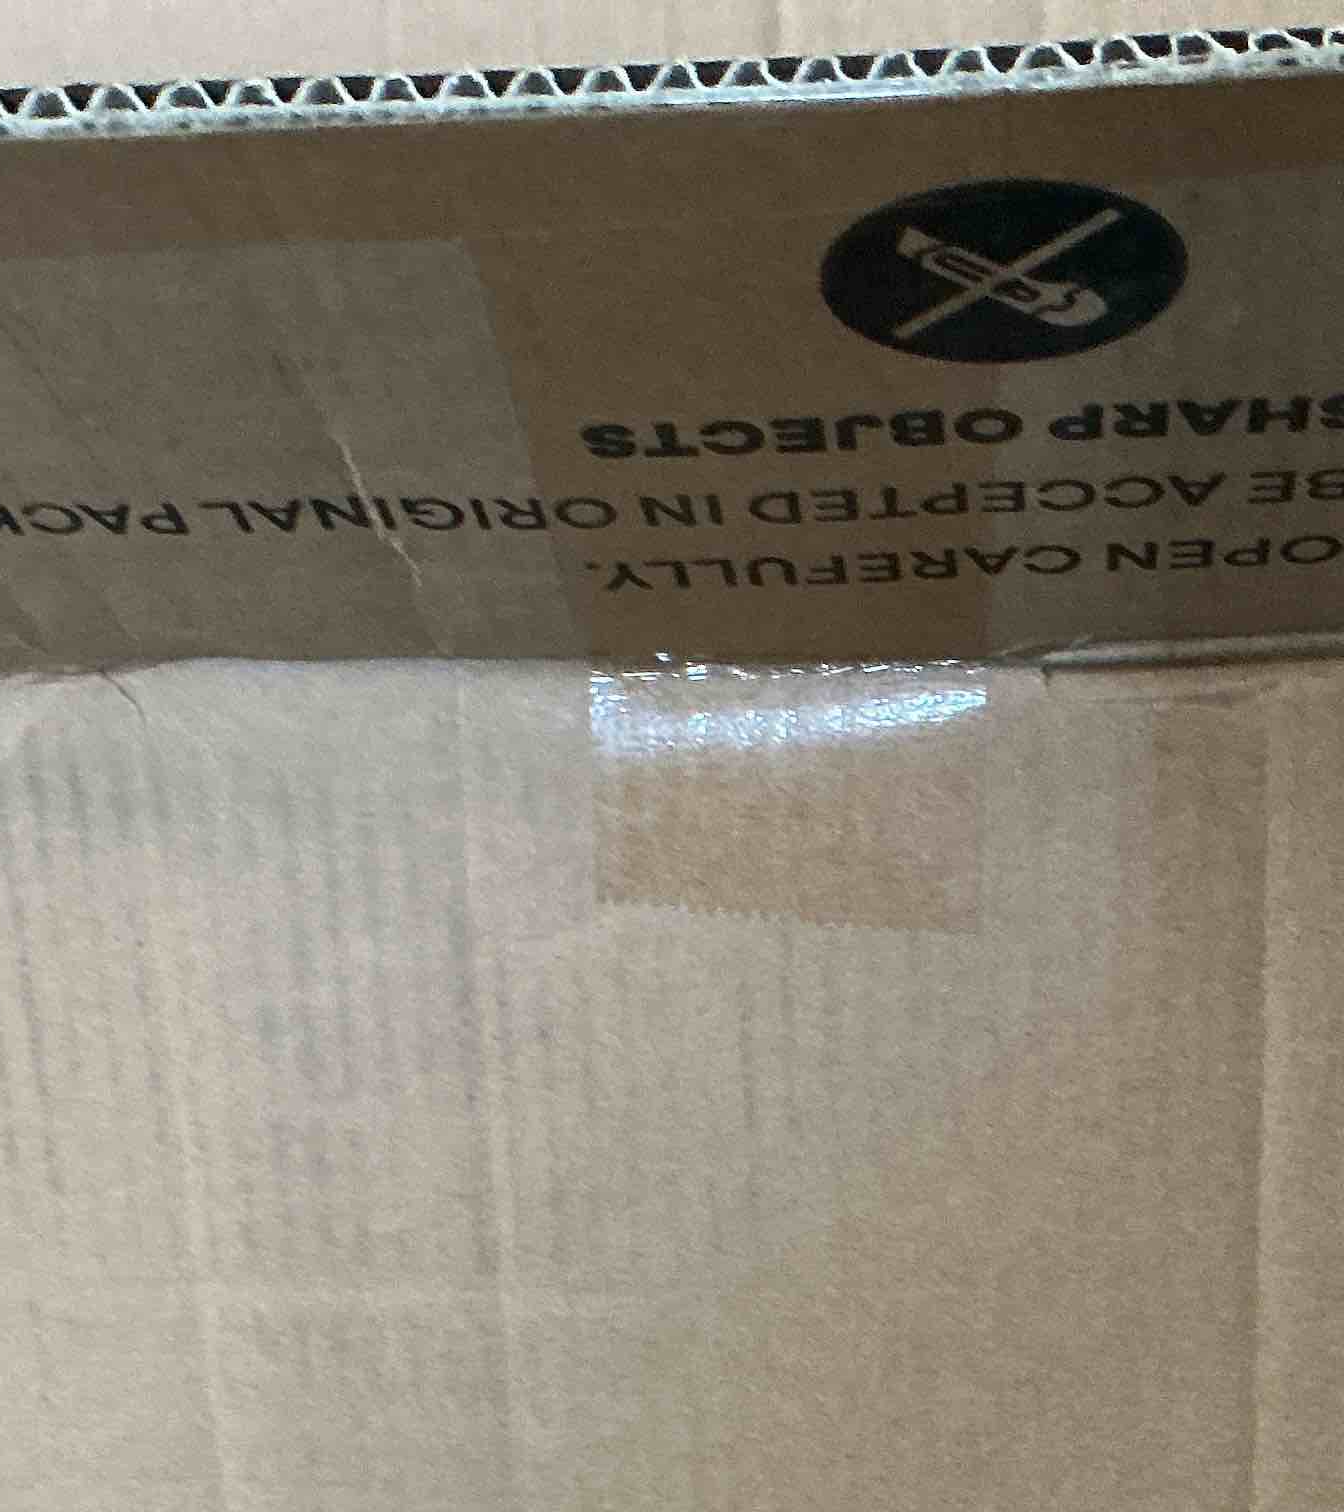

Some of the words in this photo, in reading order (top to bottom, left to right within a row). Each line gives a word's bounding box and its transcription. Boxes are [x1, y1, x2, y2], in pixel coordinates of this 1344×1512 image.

[581, 409, 1022, 457] OBJECTS
[200, 495, 616, 534] ORIGINAL
[639, 492, 718, 528] IN
[749, 472, 1223, 524] ACCEPTED
[583, 542, 1079, 590] CAREFULLY.
[1104, 531, 1343, 571] OPEN
